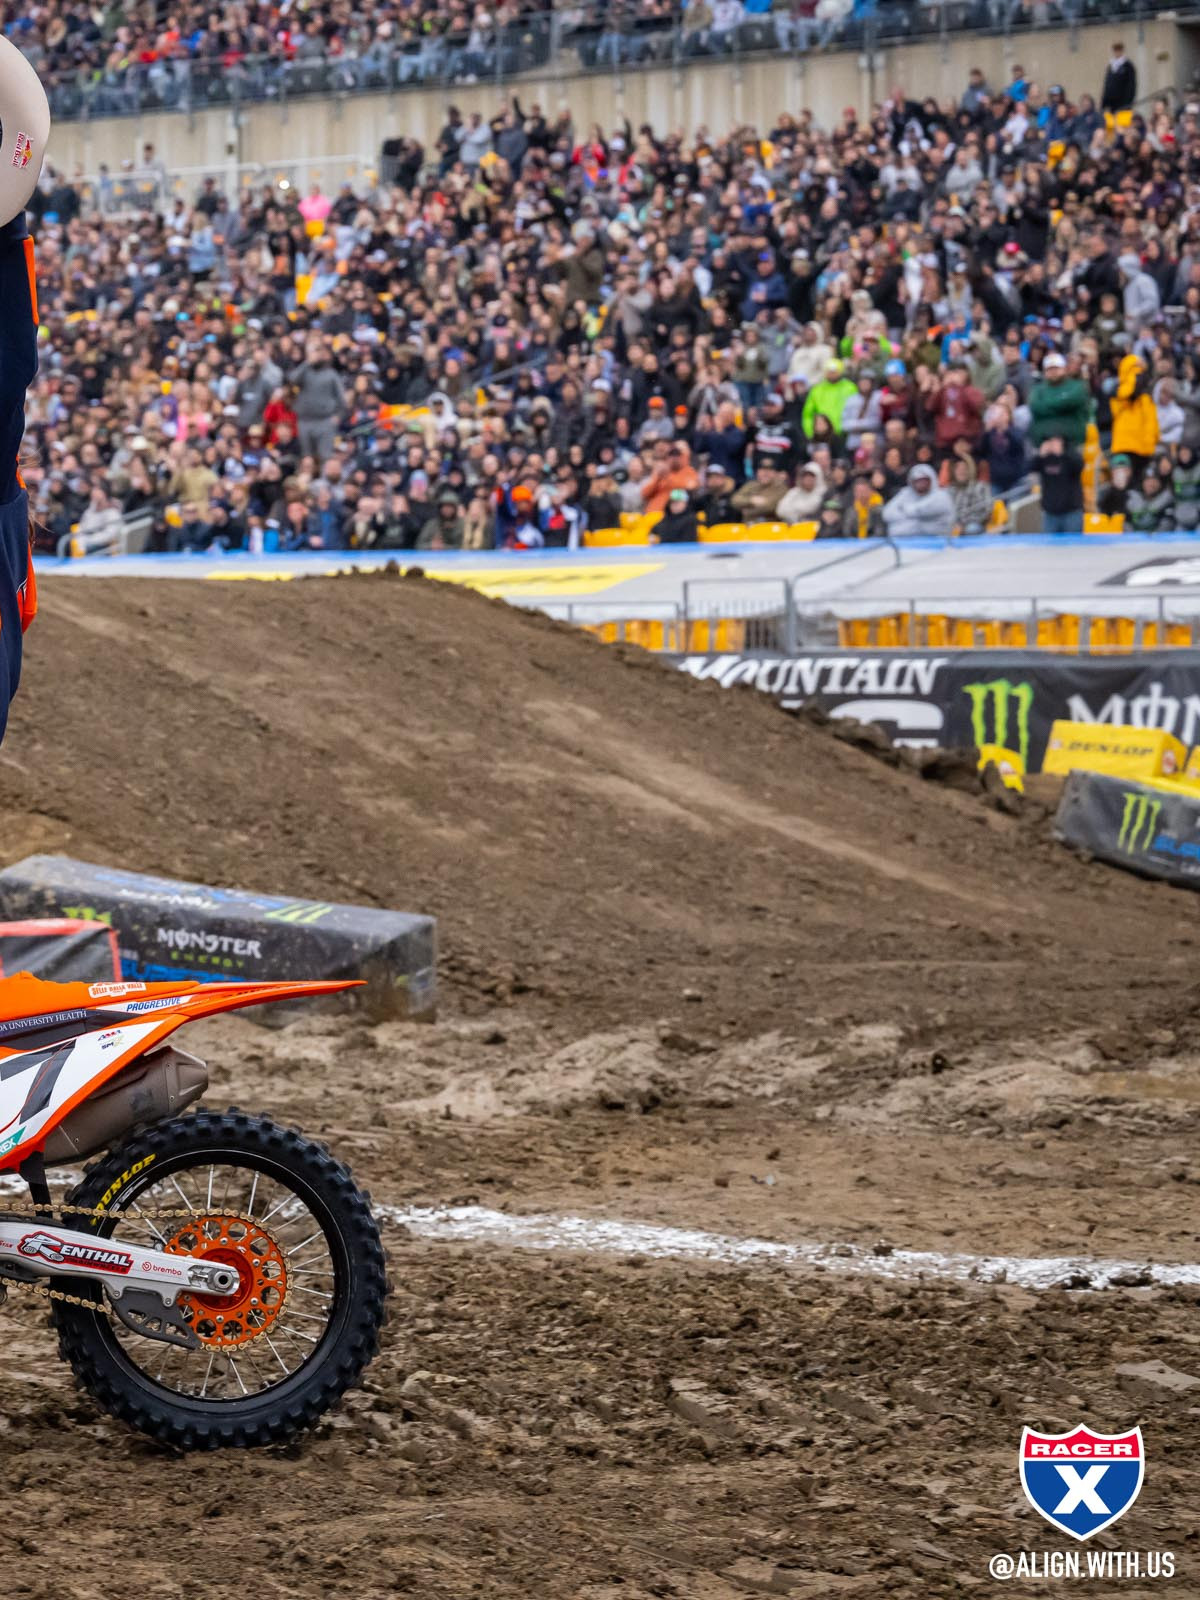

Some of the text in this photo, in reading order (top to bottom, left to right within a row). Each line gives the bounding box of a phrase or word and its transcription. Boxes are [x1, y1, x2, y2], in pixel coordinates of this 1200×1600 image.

[1068, 740, 1154, 755] DUNLOP
[157, 928, 262, 958] MONSTER
[126, 997, 181, 1011] PROGRESSIVE
[8, 1016, 55, 1032] UNIVERSITY
[55, 1010, 87, 1022] HEALTH
[0, 1039, 77, 1125] 7
[19, 1234, 132, 1267] RENTHAL
[153, 1264, 182, 1276] brembo
